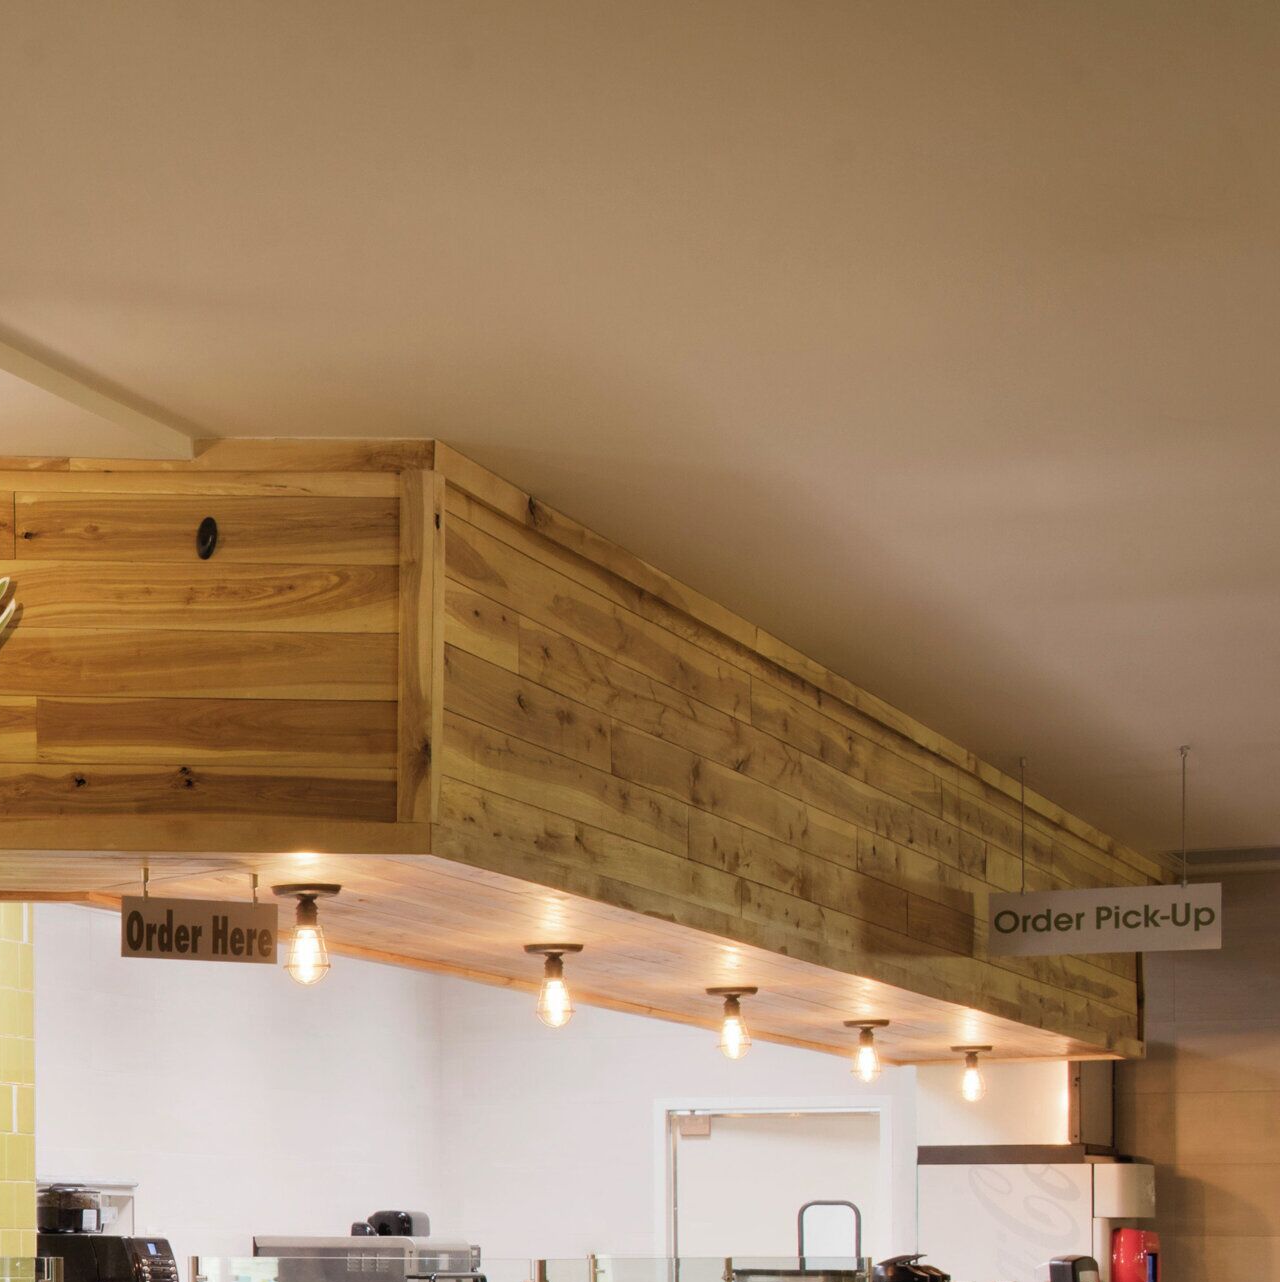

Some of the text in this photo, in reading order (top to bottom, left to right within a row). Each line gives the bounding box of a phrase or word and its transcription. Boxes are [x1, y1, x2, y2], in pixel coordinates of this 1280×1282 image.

[127, 909, 272, 957] Order Here
[994, 903, 1215, 934] Order Pick-Up
